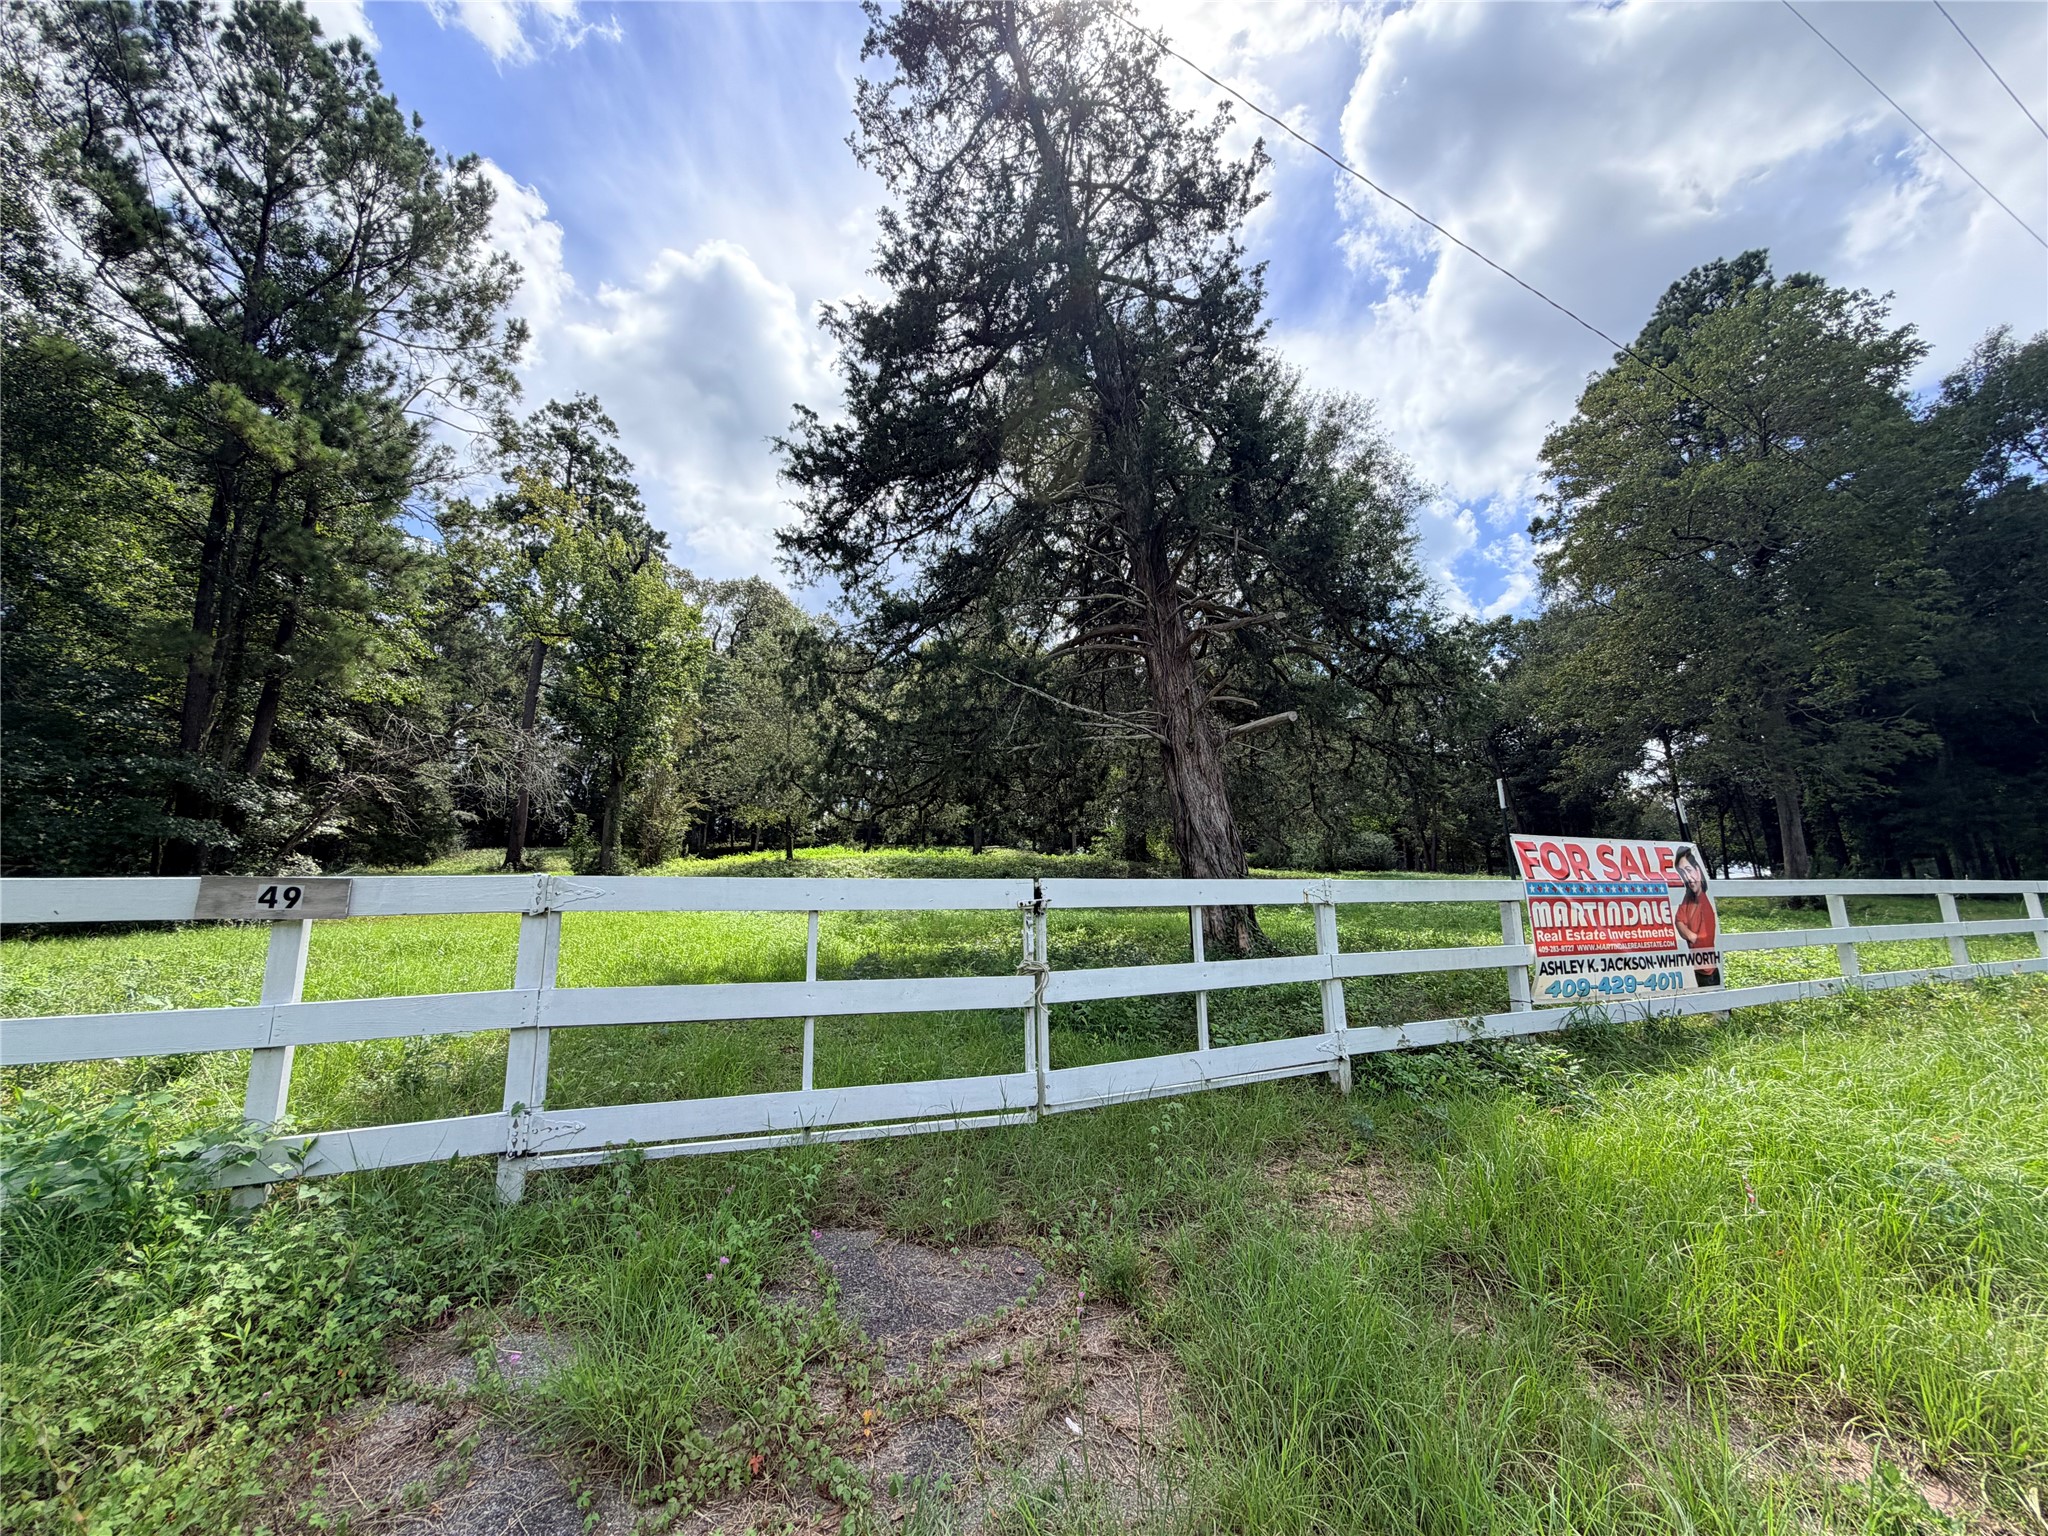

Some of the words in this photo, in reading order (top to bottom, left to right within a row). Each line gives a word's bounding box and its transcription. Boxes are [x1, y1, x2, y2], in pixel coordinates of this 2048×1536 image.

[1515, 841, 1597, 881] FOR
[1596, 844, 1682, 881] SALE
[257, 886, 302, 909] 49
[1531, 900, 1672, 928] MARTINDALE
[1536, 929, 1562, 942] Real
[1565, 929, 1606, 941] Estate
[1607, 927, 1675, 940] Investments
[1577, 940, 1675, 951] WWW.MARTINDALEREALESTATE.COM
[1539, 959, 1585, 977] ASHLEY
[1587, 957, 1599, 973] K.
[1601, 951, 1721, 972] JACKSON-WHITWORTH
[1545, 971, 1684, 999] 409-429-4011
